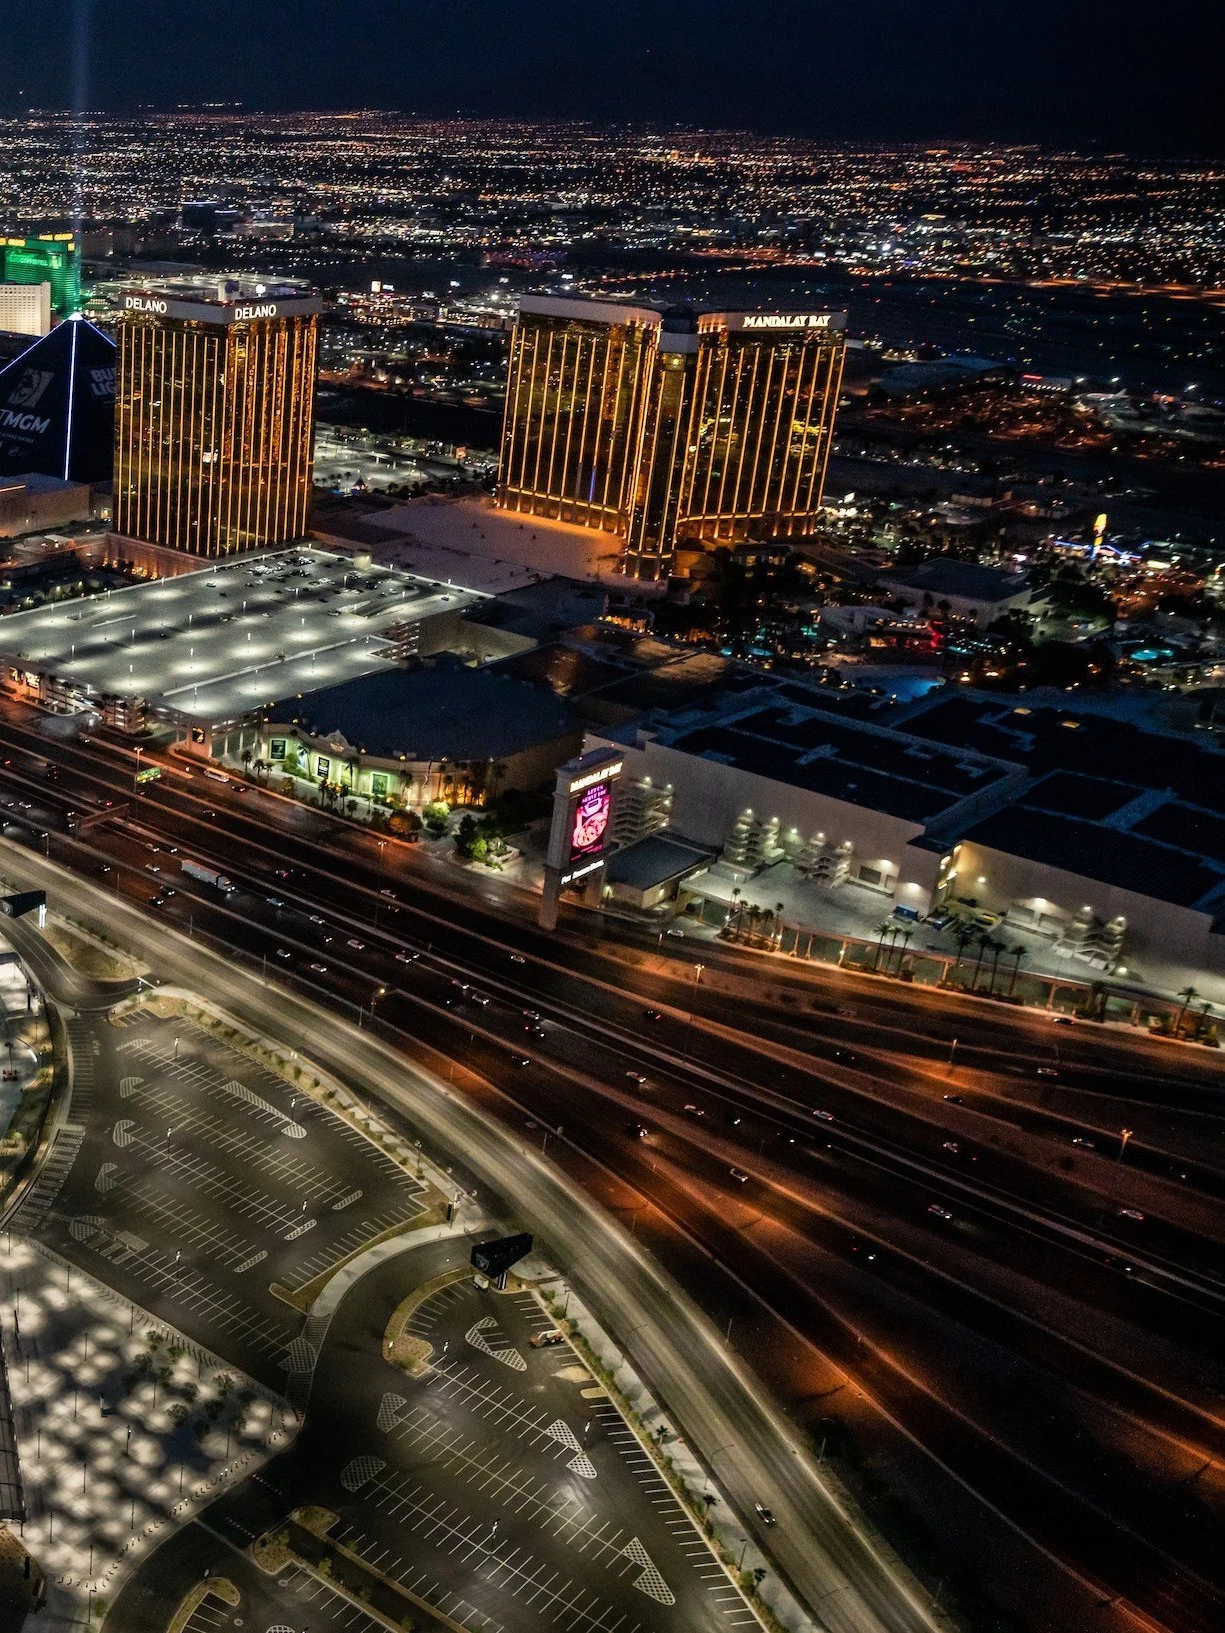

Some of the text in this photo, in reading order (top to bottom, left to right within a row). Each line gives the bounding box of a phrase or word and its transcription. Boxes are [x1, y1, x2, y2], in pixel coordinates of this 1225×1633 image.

[125, 297, 168, 314] DELANO
[234, 304, 277, 320] DELANO
[742, 315, 831, 328] MANDALAY BAY
[90, 367, 116, 382] BU
